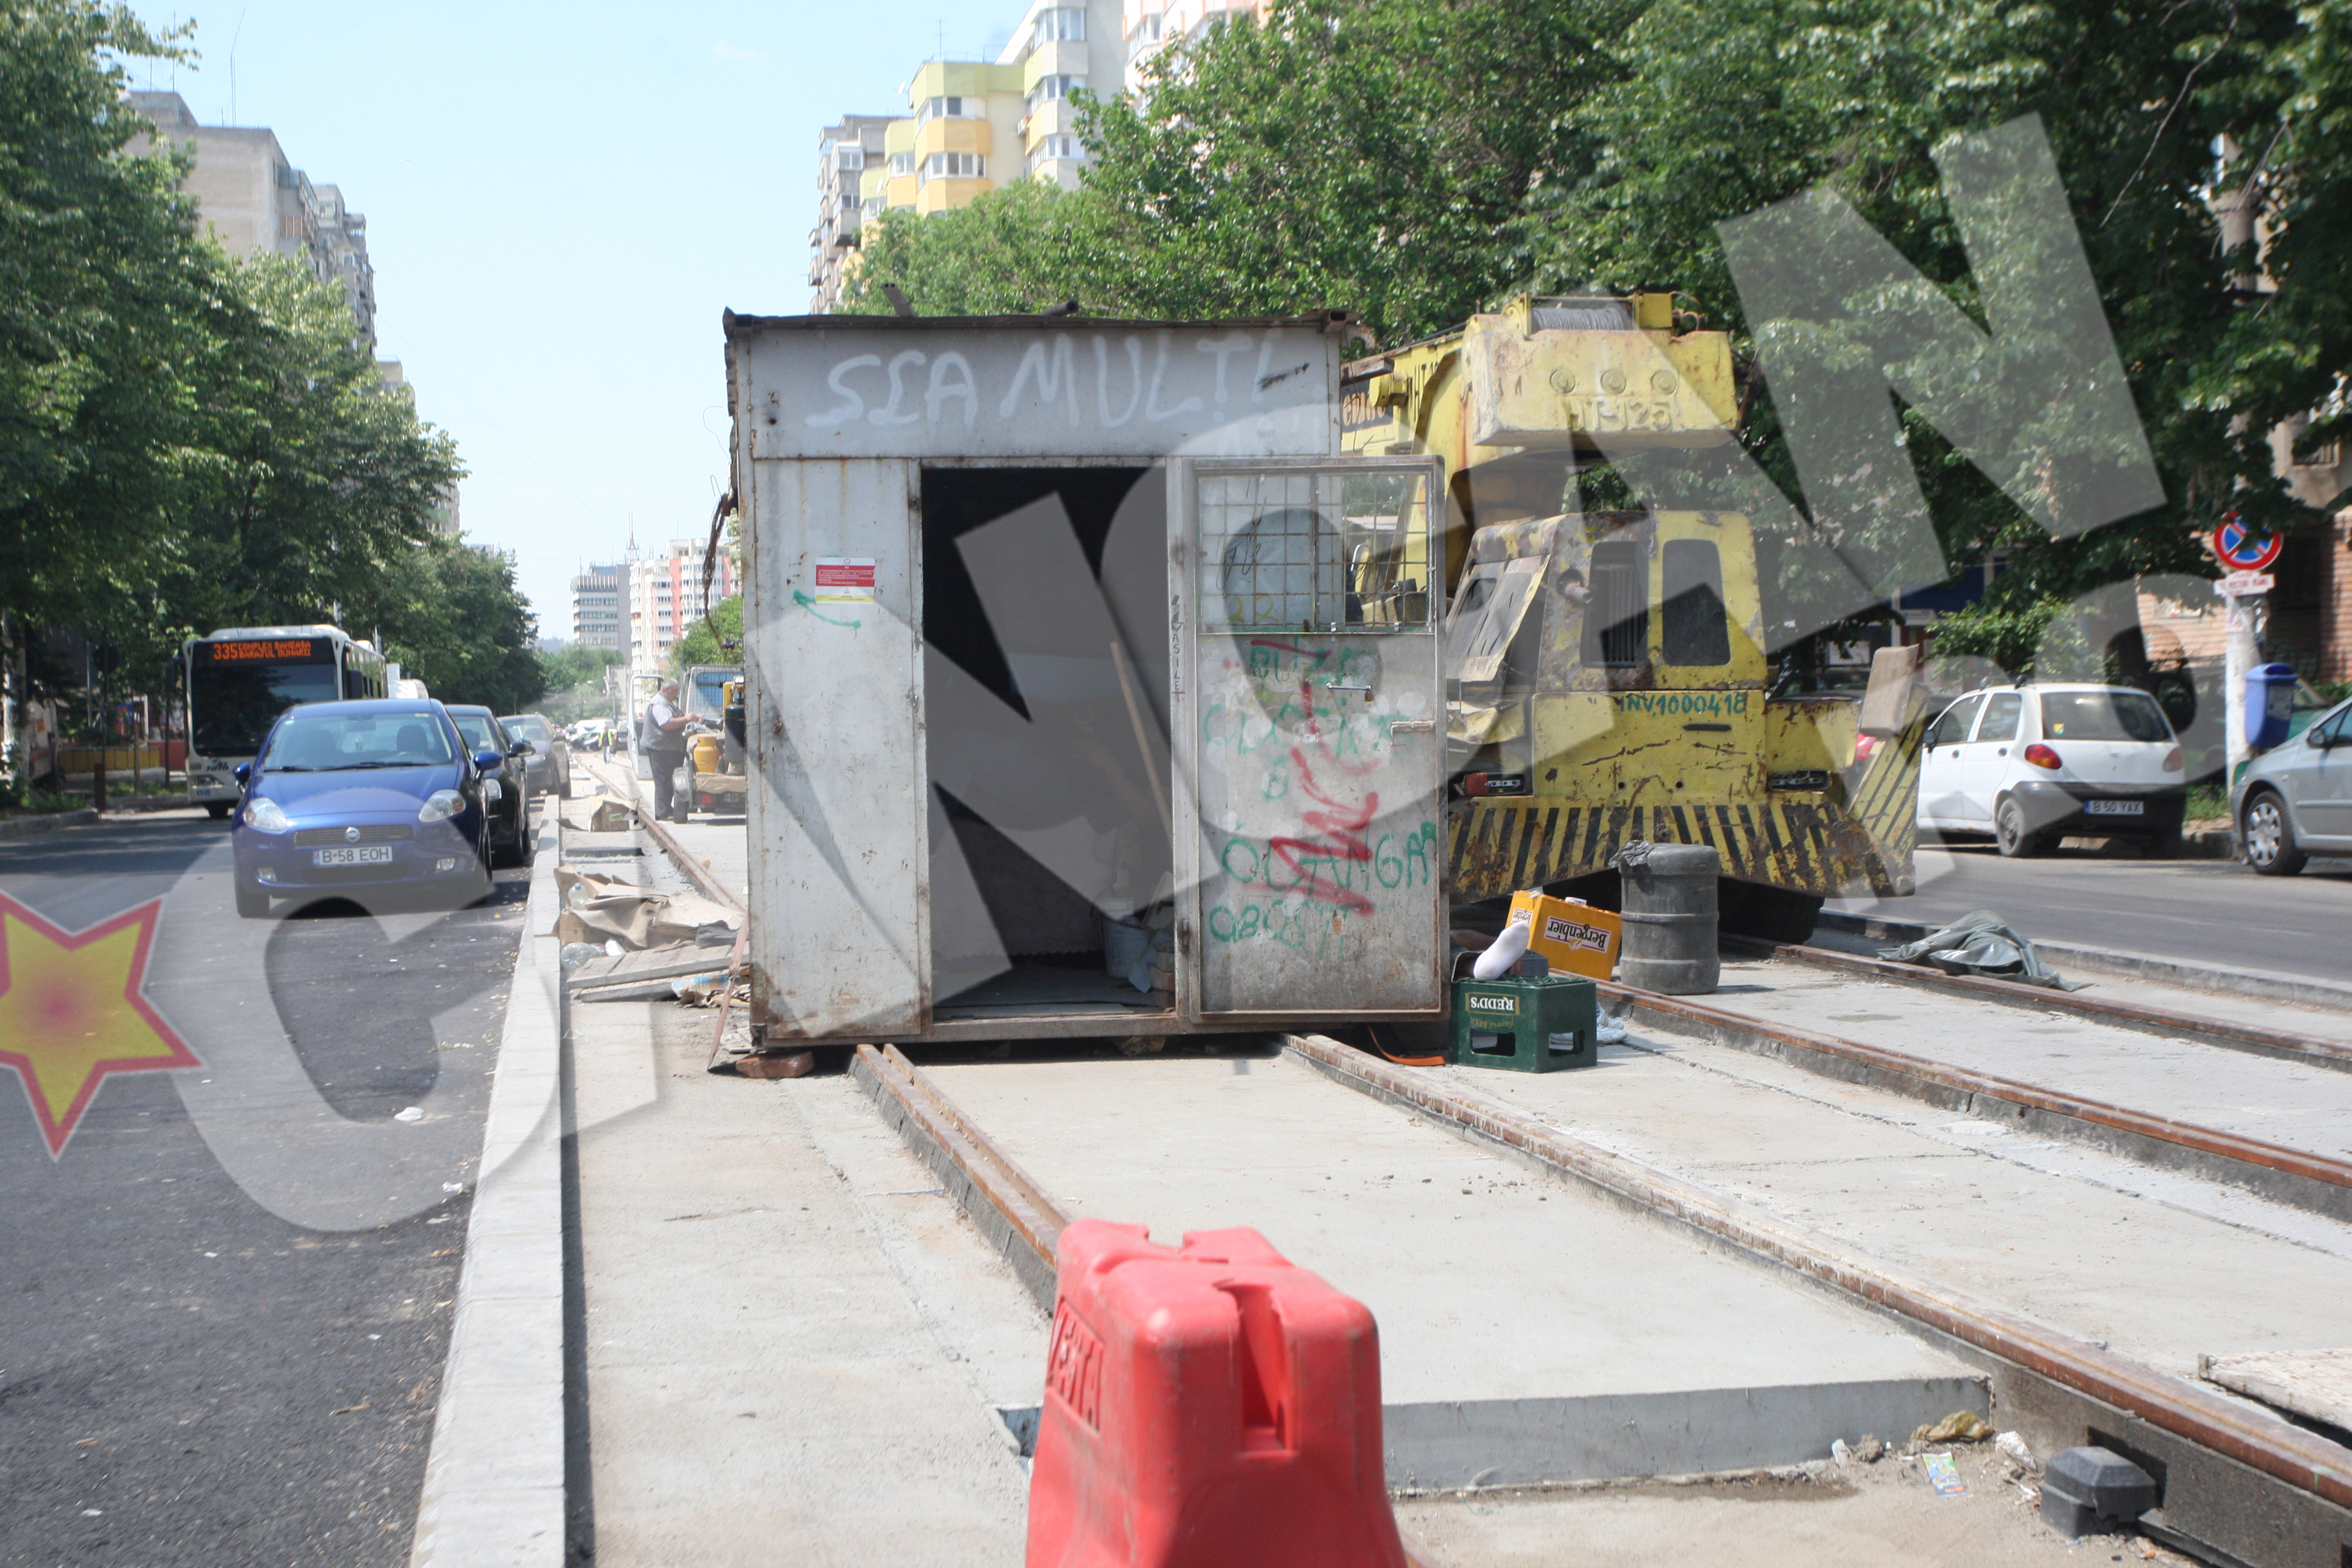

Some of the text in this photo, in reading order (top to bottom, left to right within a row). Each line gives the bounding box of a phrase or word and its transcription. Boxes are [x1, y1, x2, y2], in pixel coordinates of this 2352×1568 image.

[213, 642, 238, 660] 335
[1171, 624, 1181, 690] VASILE
[322, 848, 388, 863] B 58 EOH
[1548, 920, 1607, 949] Bergenbier
[1471, 996, 1514, 1011] REDD'S
